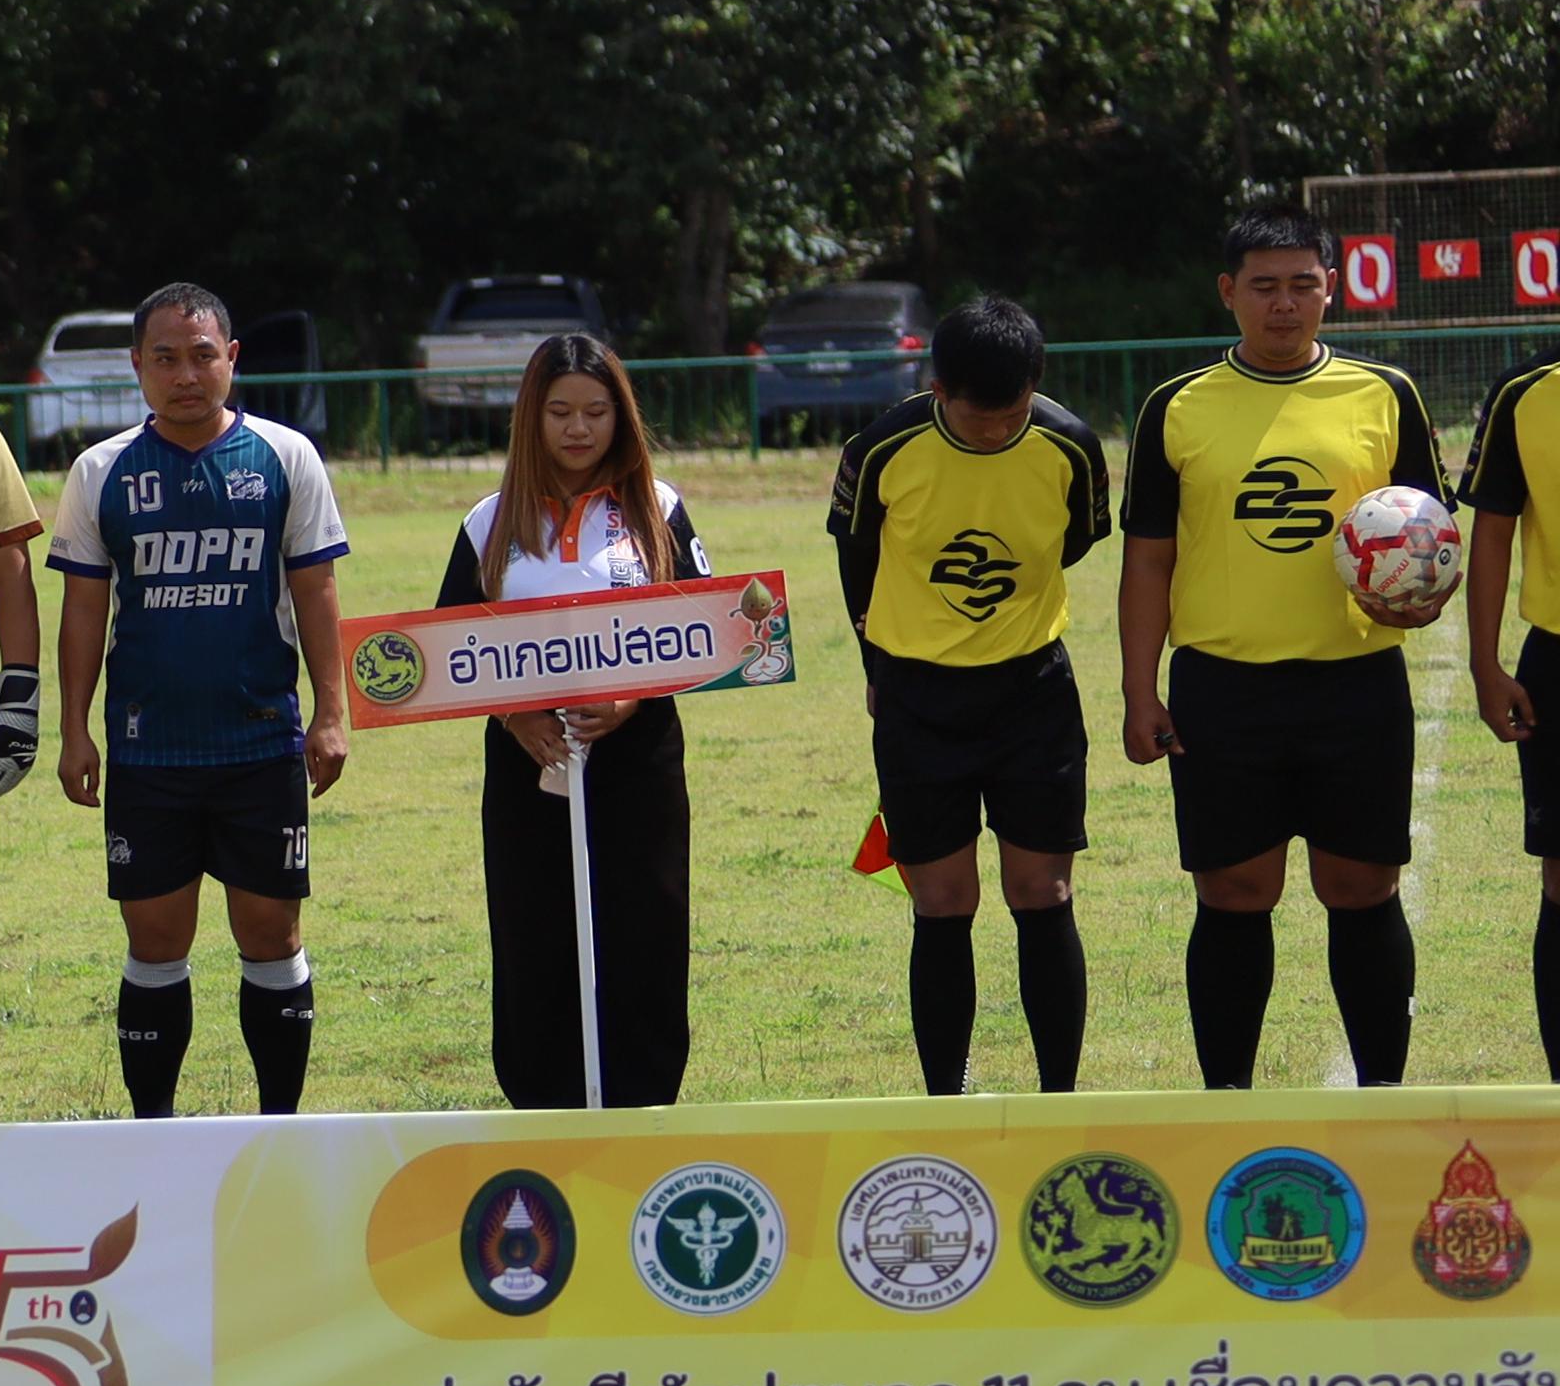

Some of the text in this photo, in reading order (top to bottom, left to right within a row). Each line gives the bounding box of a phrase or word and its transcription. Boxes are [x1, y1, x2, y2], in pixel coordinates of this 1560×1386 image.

[1347, 242, 1391, 303] 0
[121, 470, 163, 514] 10
[132, 528, 265, 577] DOPA
[143, 583, 249, 609] MAESOT
[1378, 558, 1409, 593] molten
[449, 618, 713, 685] อำเภอแม่สอด
[282, 825, 308, 870] 10
[27, 1295, 62, 1320] th
